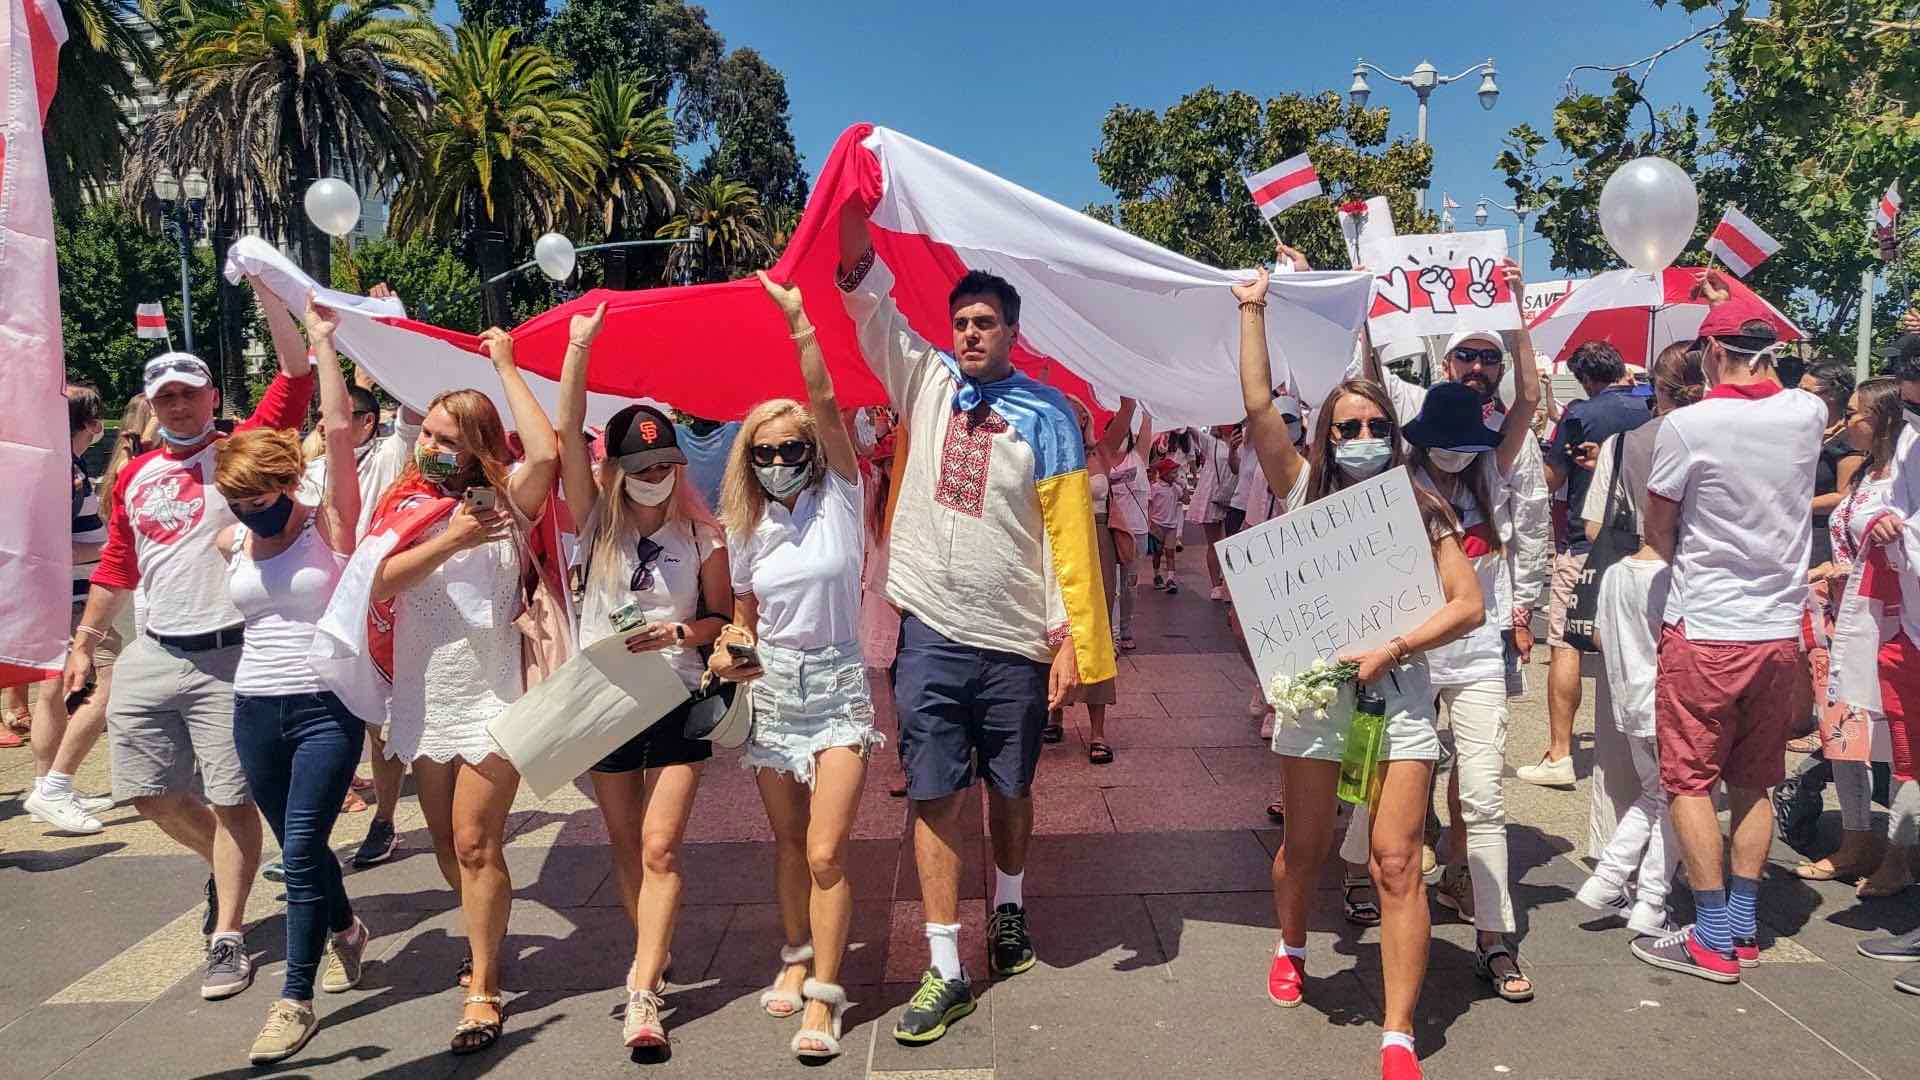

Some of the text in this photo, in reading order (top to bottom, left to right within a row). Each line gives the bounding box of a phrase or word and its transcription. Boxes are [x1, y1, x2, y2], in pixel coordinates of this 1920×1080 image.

[1225, 481, 1400, 576] ОСТАНОВИТЕ
[1265, 522, 1395, 600] НАСИЛИЕ!
[1576, 569, 1597, 585] HT
[1251, 594, 1334, 657] ЖЫВЕ
[1311, 585, 1432, 660] БЕЛАРУСЬ
[1563, 619, 1594, 636] ASTE
[1568, 593, 1579, 609] R
